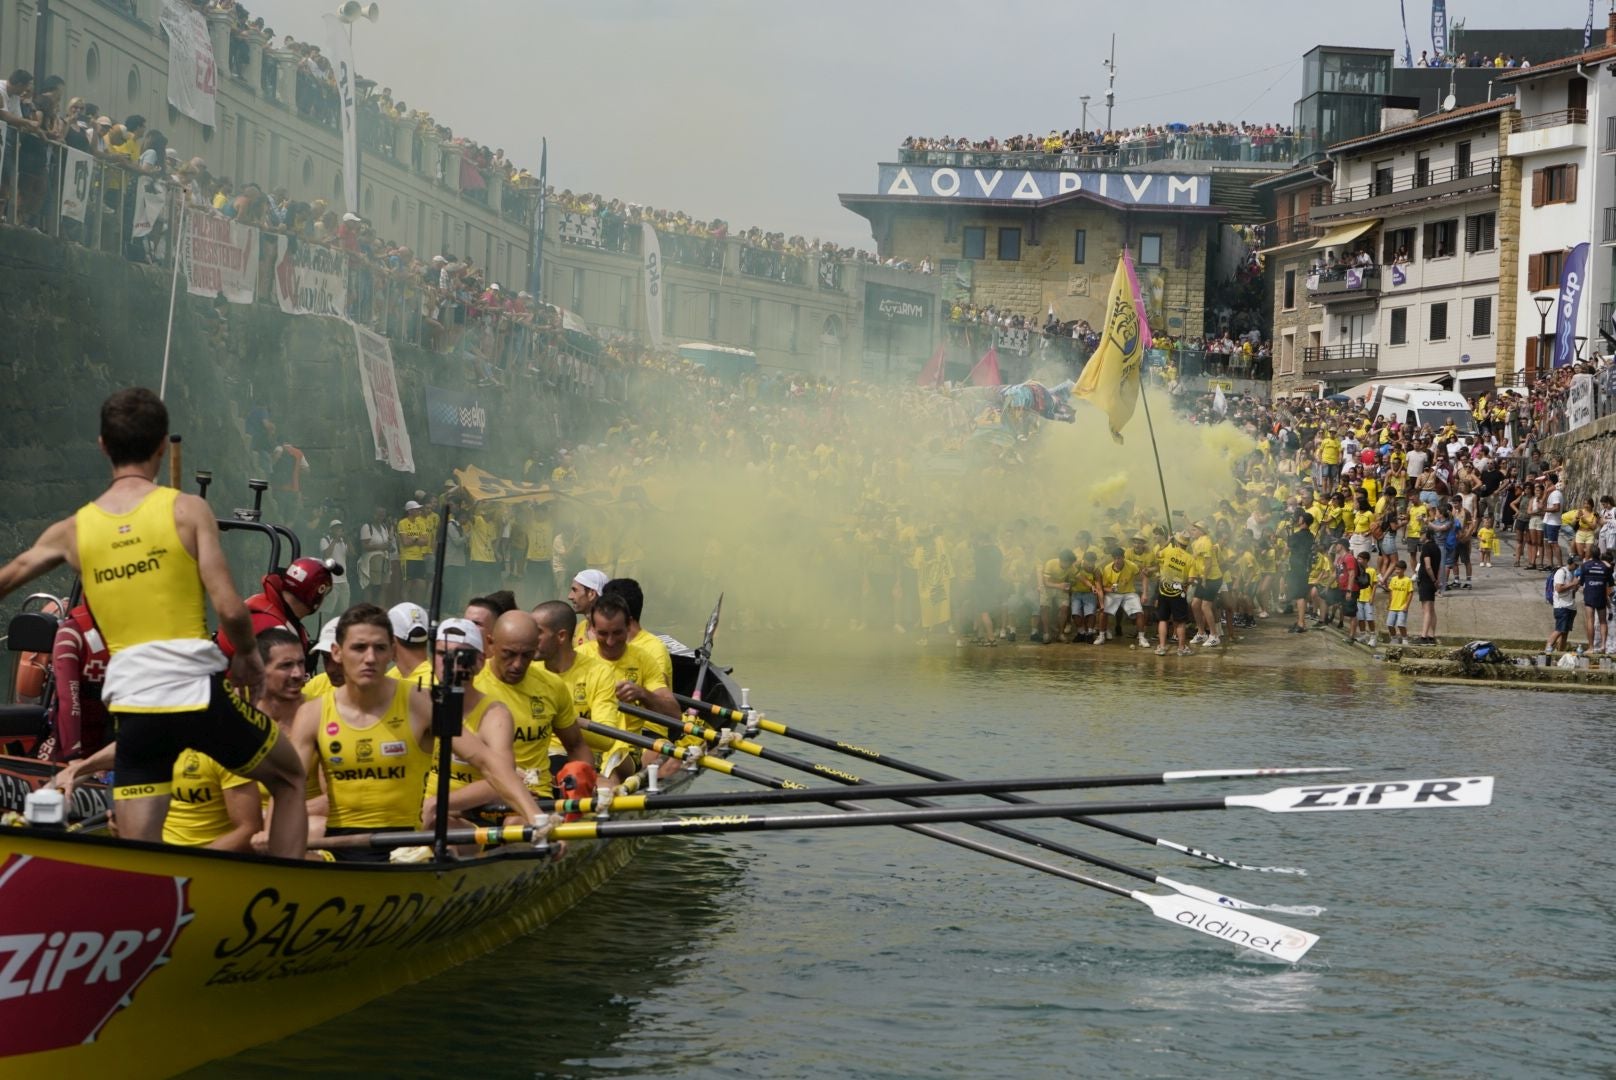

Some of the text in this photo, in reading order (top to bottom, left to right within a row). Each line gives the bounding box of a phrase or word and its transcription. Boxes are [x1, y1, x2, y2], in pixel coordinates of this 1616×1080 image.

[1421, 399, 1464, 408] overon
[93, 557, 160, 584] iraupen
[334, 766, 406, 781] ORIALKI
[121, 785, 156, 797] ORIO
[1176, 910, 1282, 952] aldinet
